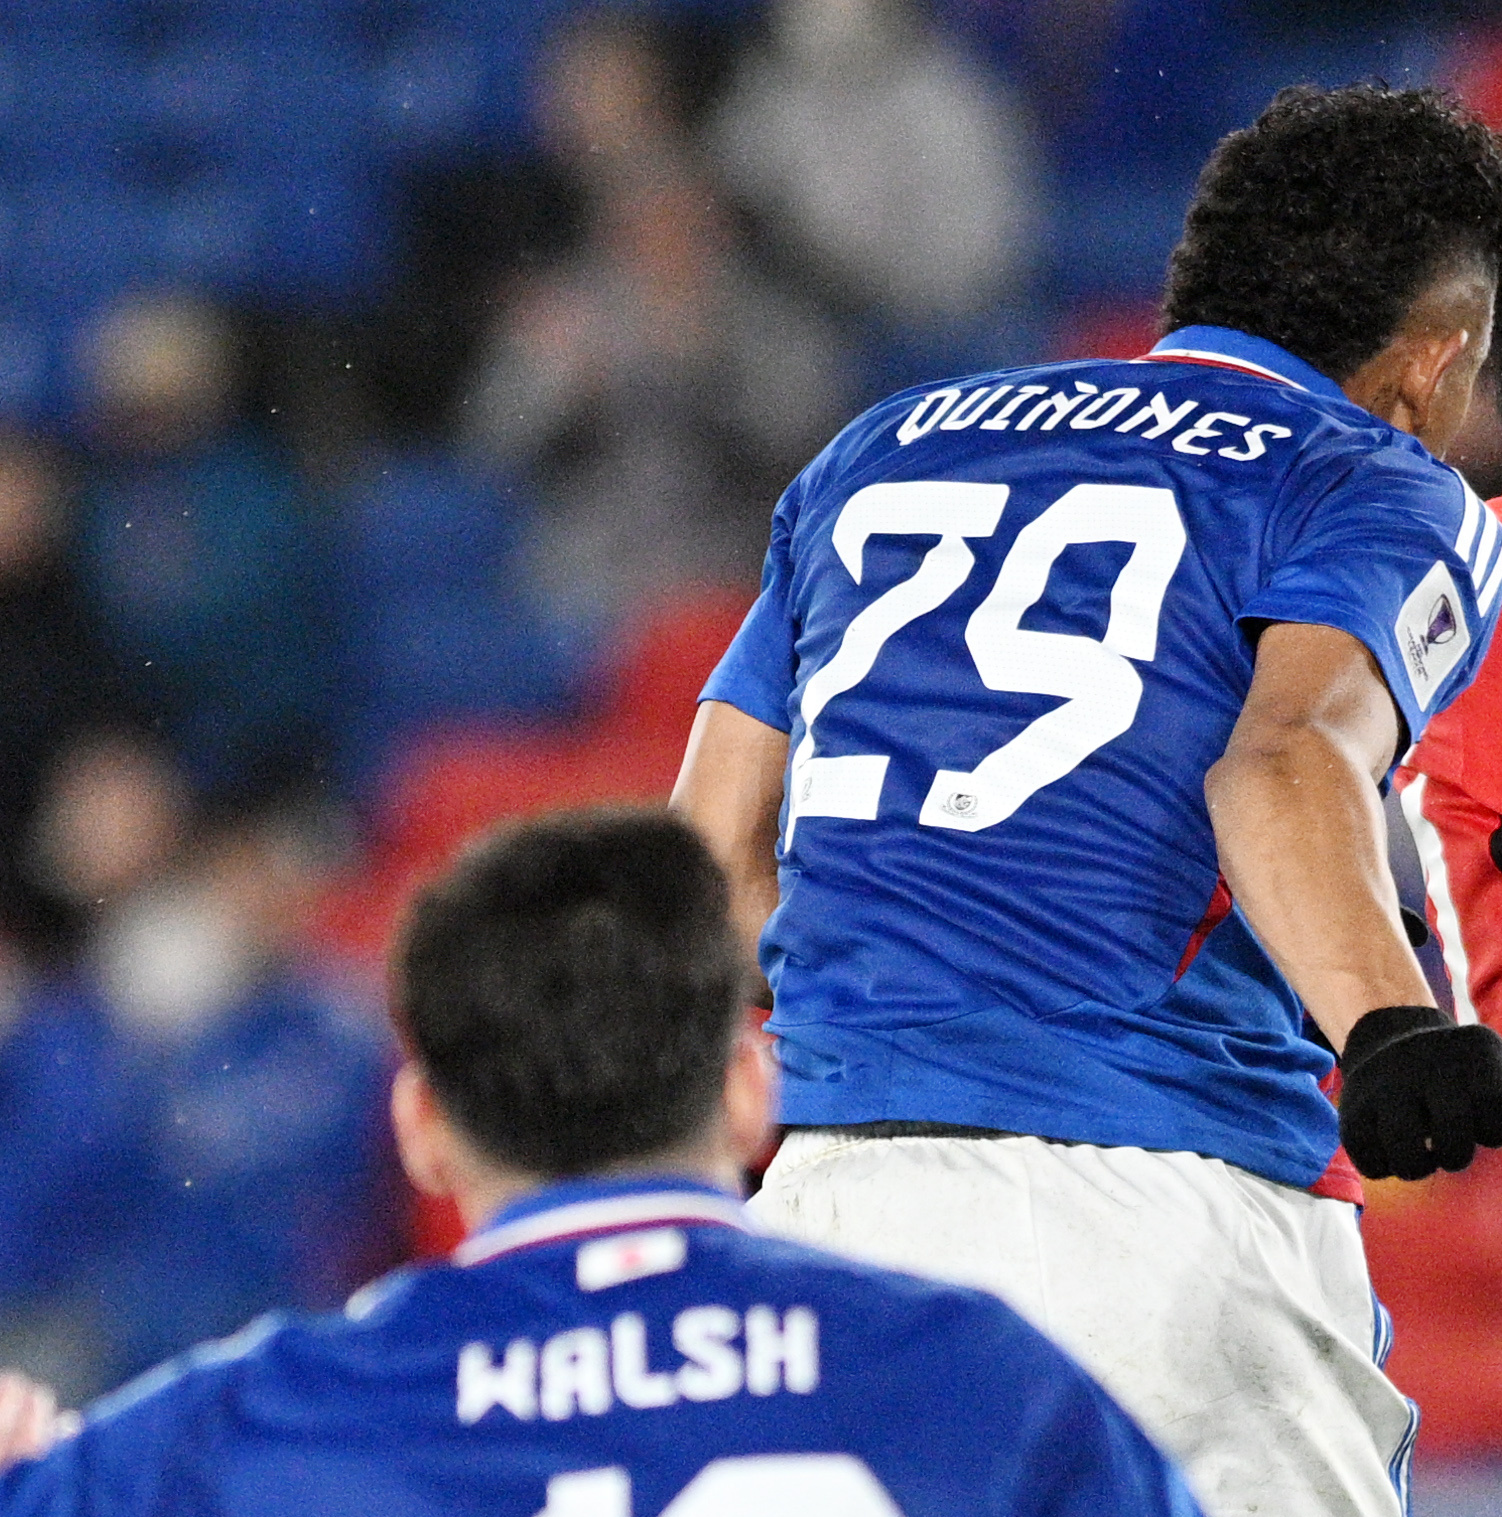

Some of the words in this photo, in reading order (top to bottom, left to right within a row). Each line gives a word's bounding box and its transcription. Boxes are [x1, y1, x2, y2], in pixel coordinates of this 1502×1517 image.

[895, 380, 1293, 462] QUIÑONES
[783, 479, 1188, 855] 29
[455, 1304, 820, 1424] WALSH
